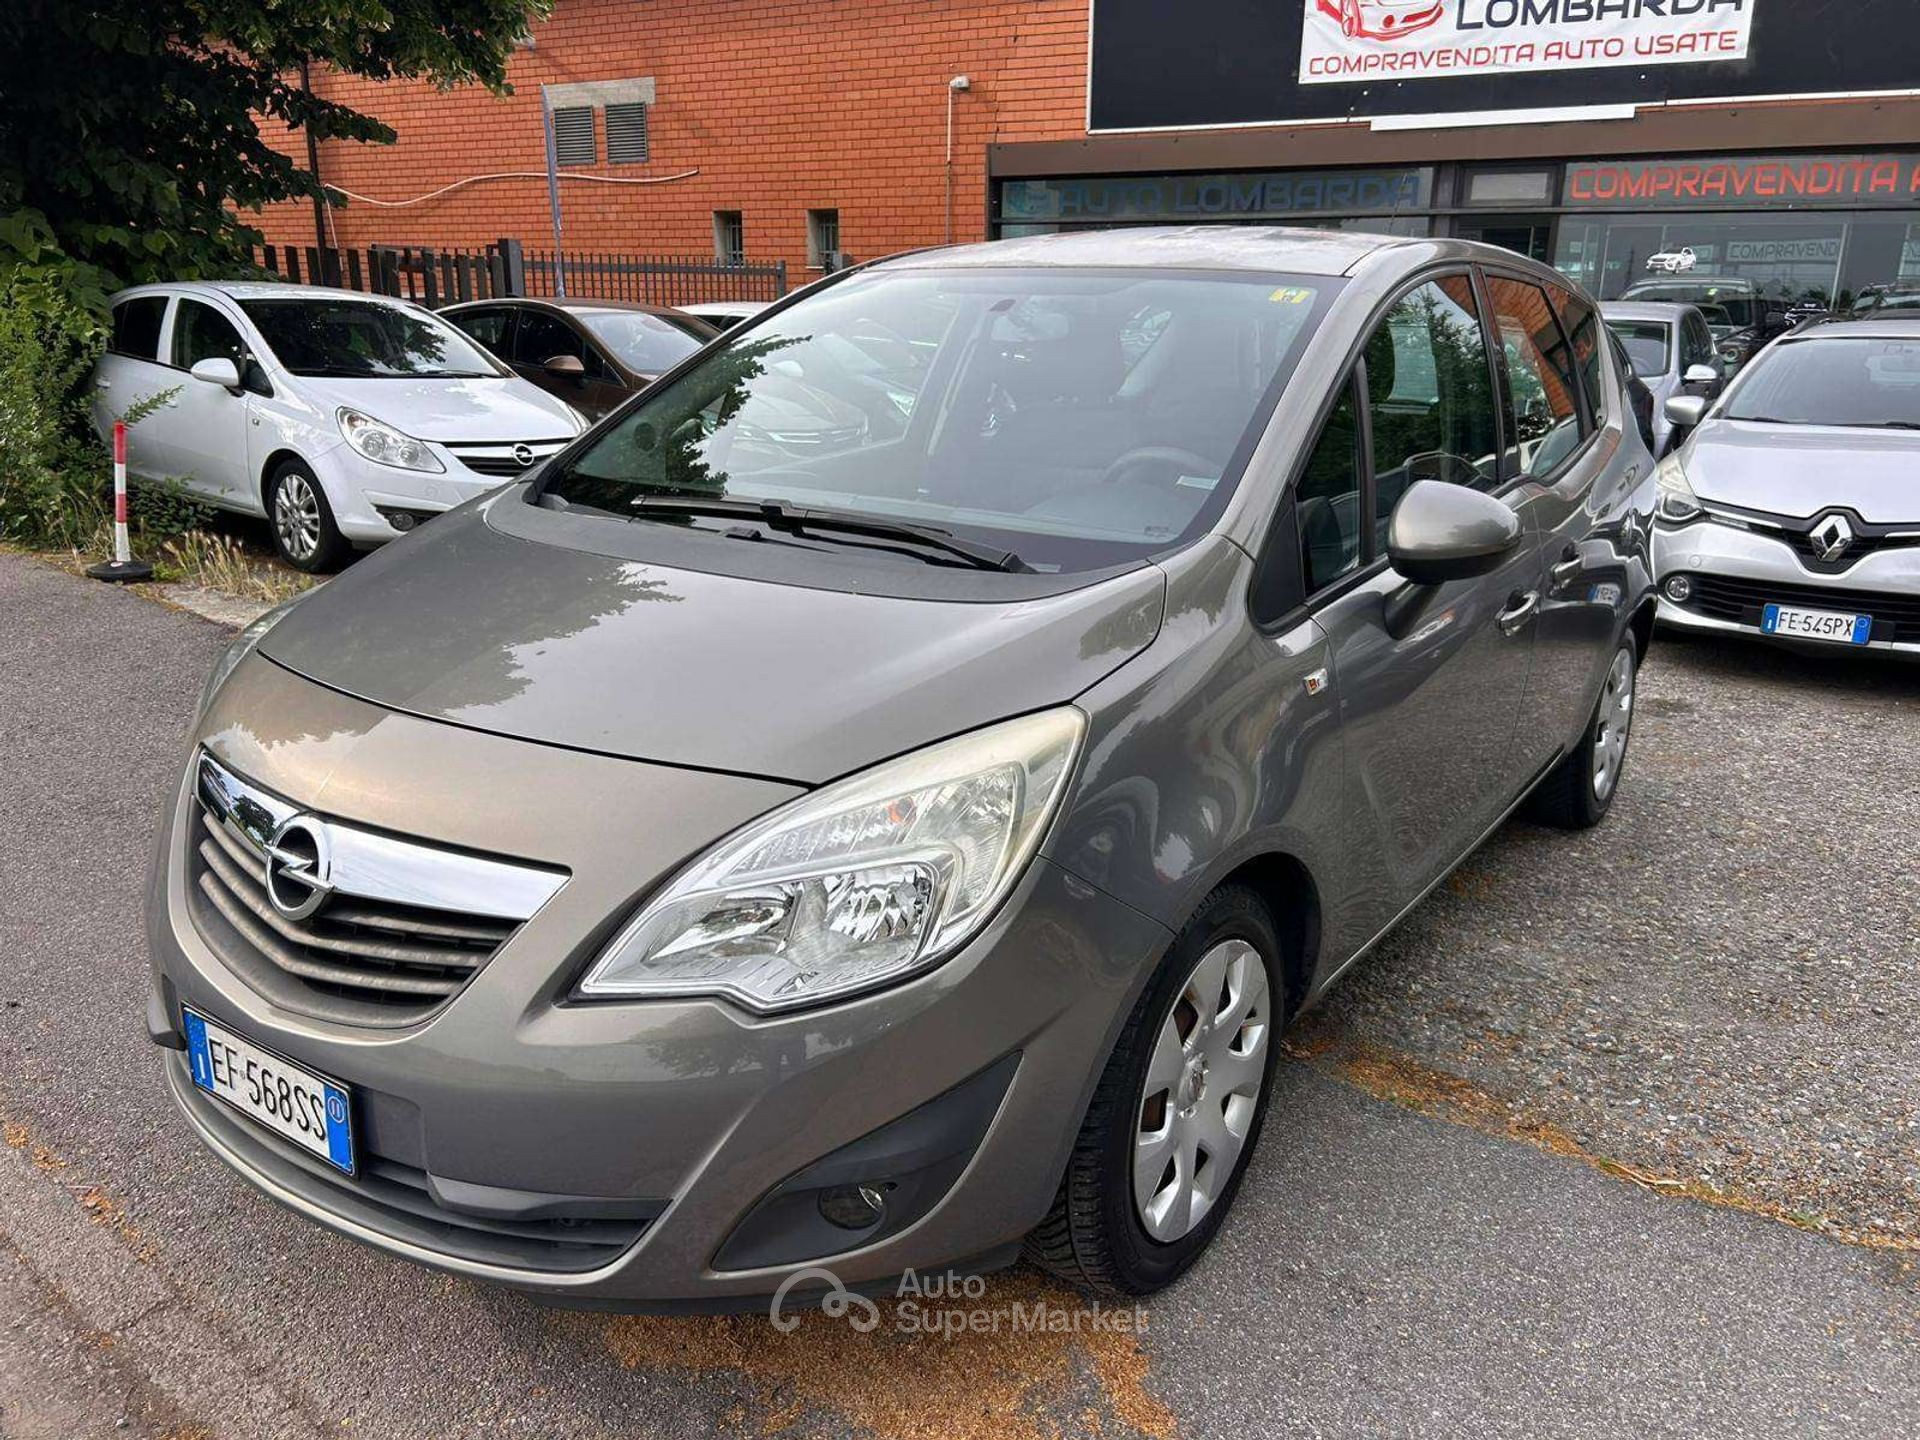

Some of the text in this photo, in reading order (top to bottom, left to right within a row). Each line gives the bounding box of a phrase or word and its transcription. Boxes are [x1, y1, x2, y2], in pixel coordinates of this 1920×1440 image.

[1309, 30, 1738, 75] COMPRAVENDITA AUTO USATE
[1059, 176, 1420, 214] AUTO LOMBARDA
[1571, 160, 1899, 199] COMPRAVENDITA
